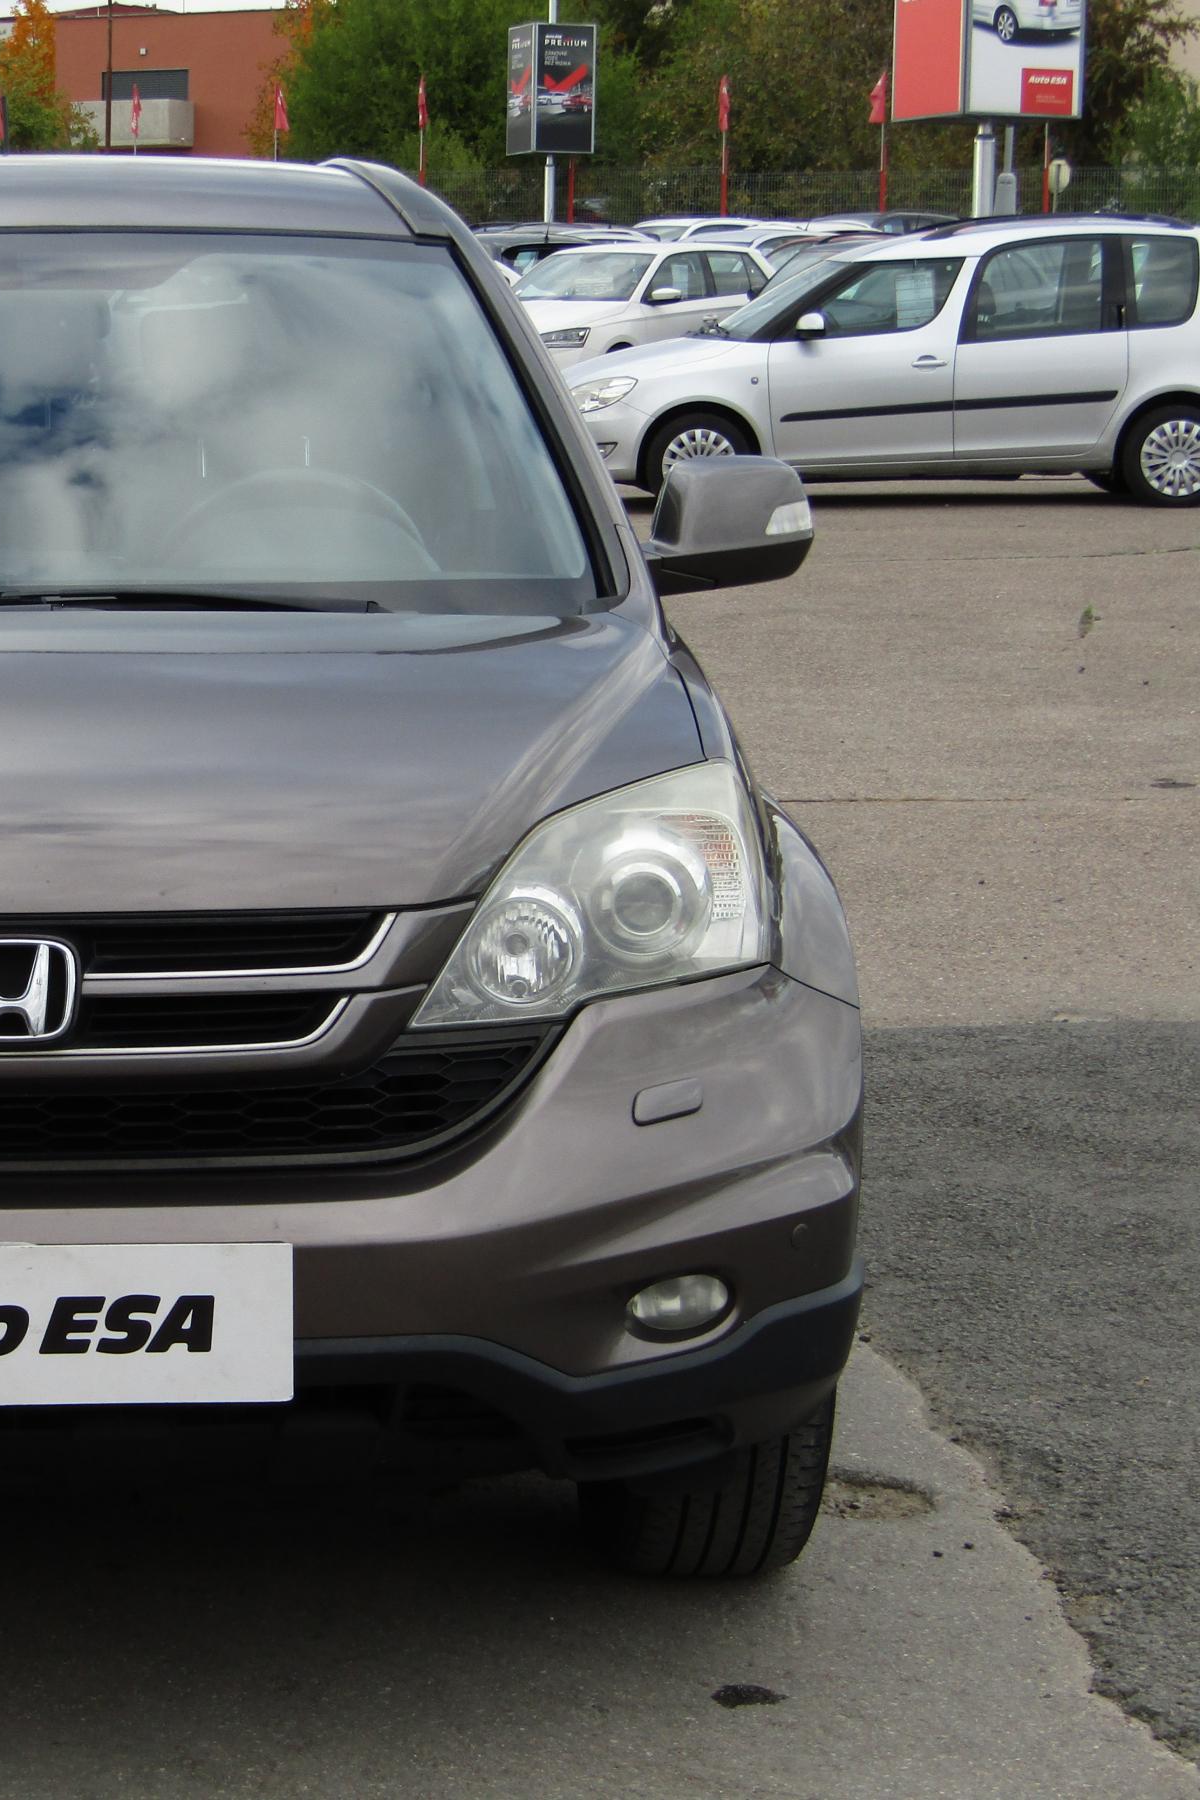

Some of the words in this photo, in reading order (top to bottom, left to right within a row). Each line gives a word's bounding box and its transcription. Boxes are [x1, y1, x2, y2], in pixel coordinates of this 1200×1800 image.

[1028, 75, 1050, 84] Auto
[1050, 76, 1068, 85] ESA
[39, 1295, 215, 1355] ESA
